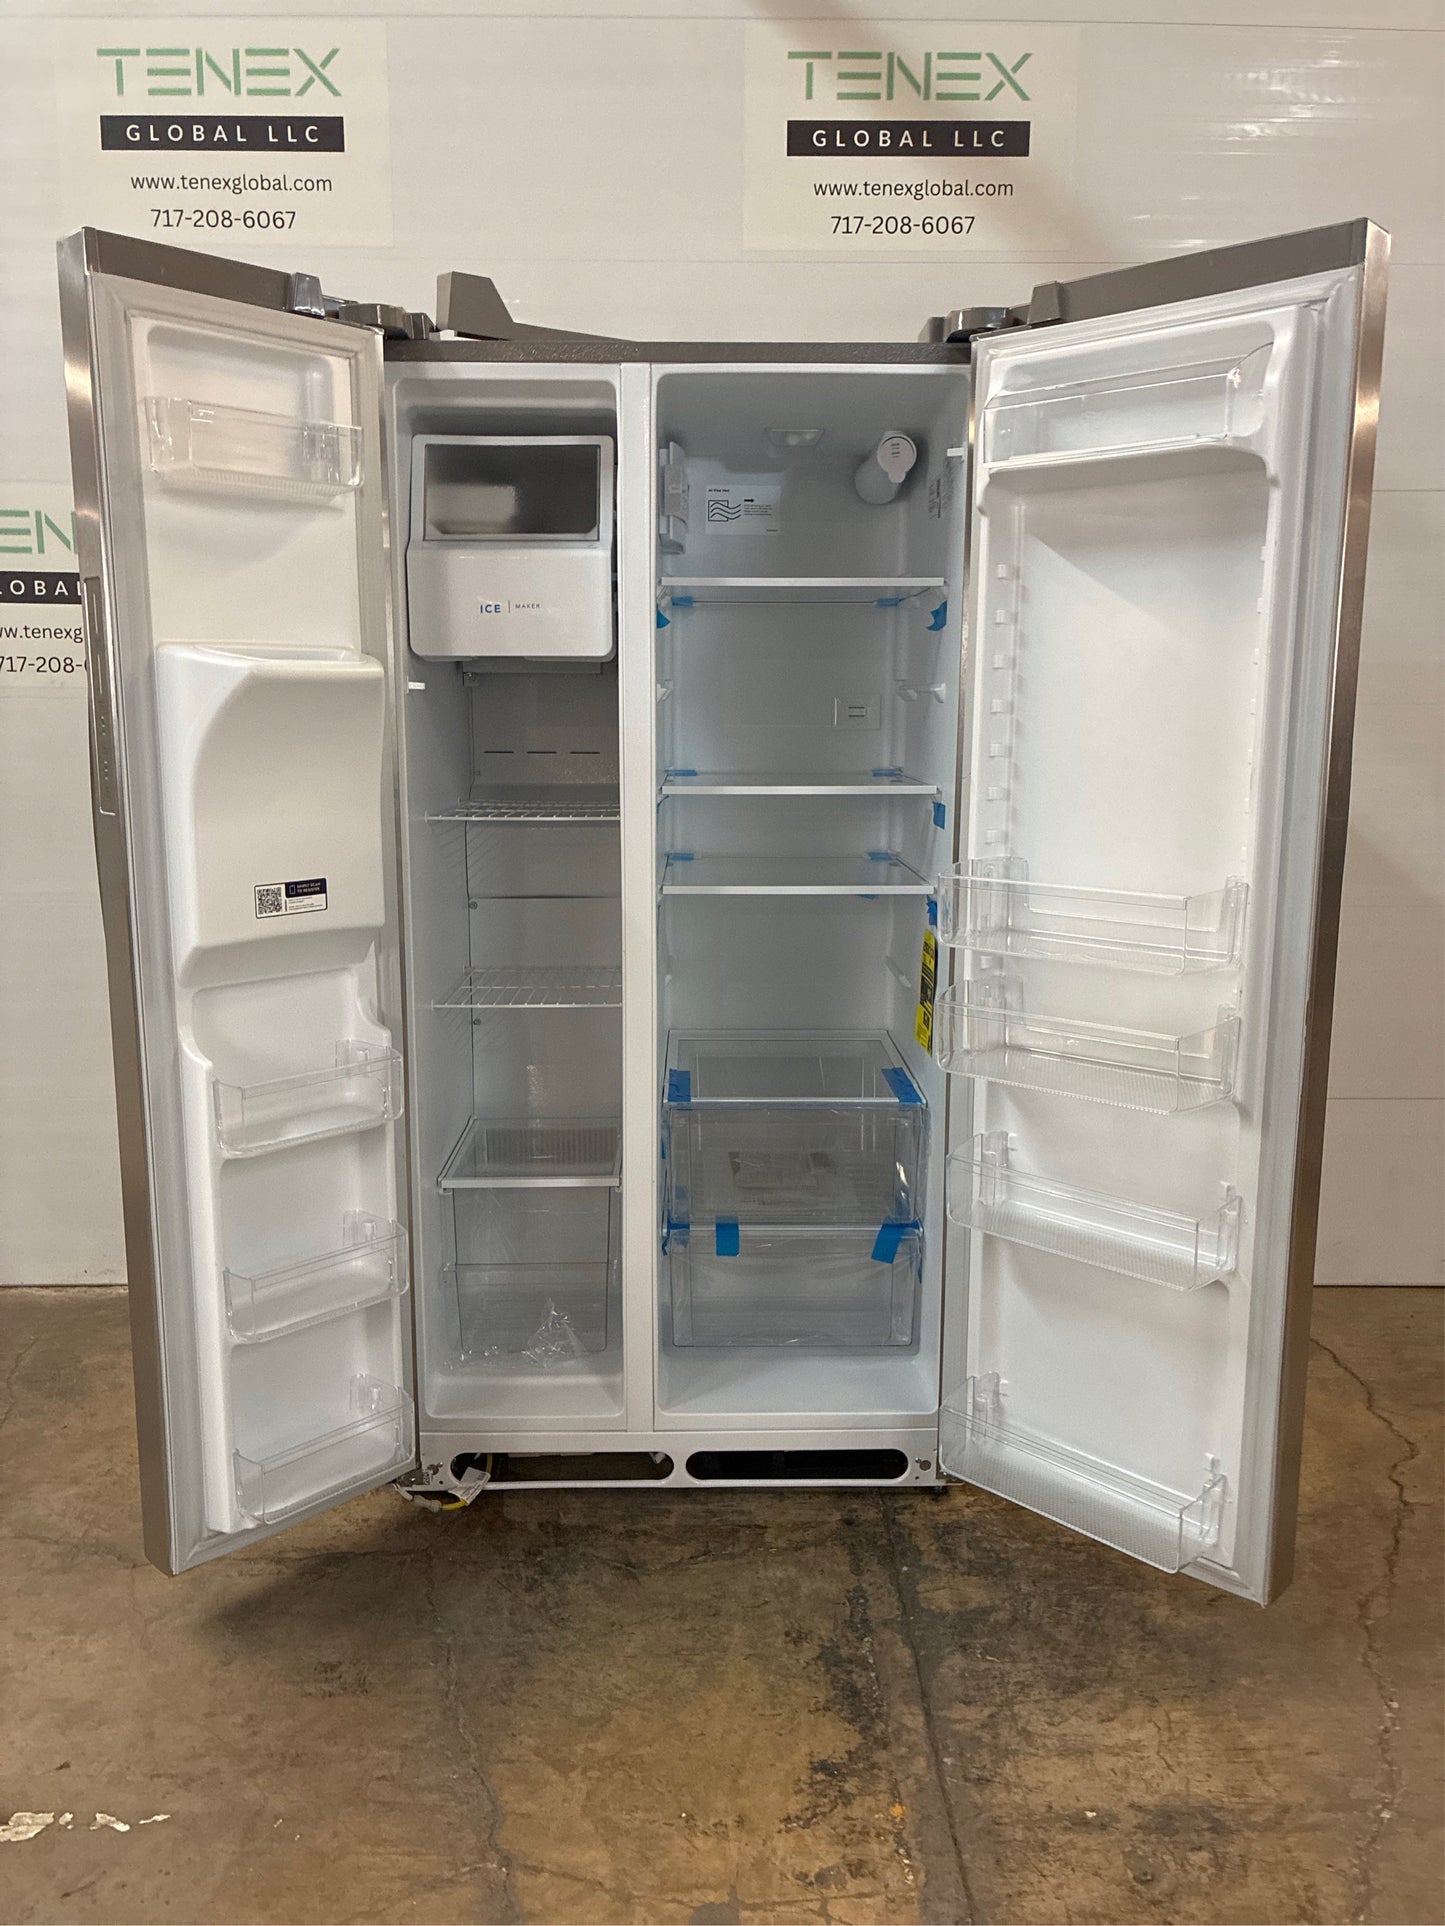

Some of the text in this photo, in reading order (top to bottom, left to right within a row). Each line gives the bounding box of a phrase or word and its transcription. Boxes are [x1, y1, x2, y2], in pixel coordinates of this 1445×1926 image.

[97, 48, 341, 96] TENEX
[788, 51, 1032, 100] TENEX
[126, 124, 319, 143] GLOBAL LLC
[812, 129, 1004, 148] GLOBAL LLC
[130, 174, 332, 195] www.tenexglobal.com
[813, 179, 1014, 201] www.tenexglobal.com
[150, 209, 296, 230] 717-208-6067
[831, 215, 976, 235] 717-208-6067
[480, 604, 501, 614] ICE
